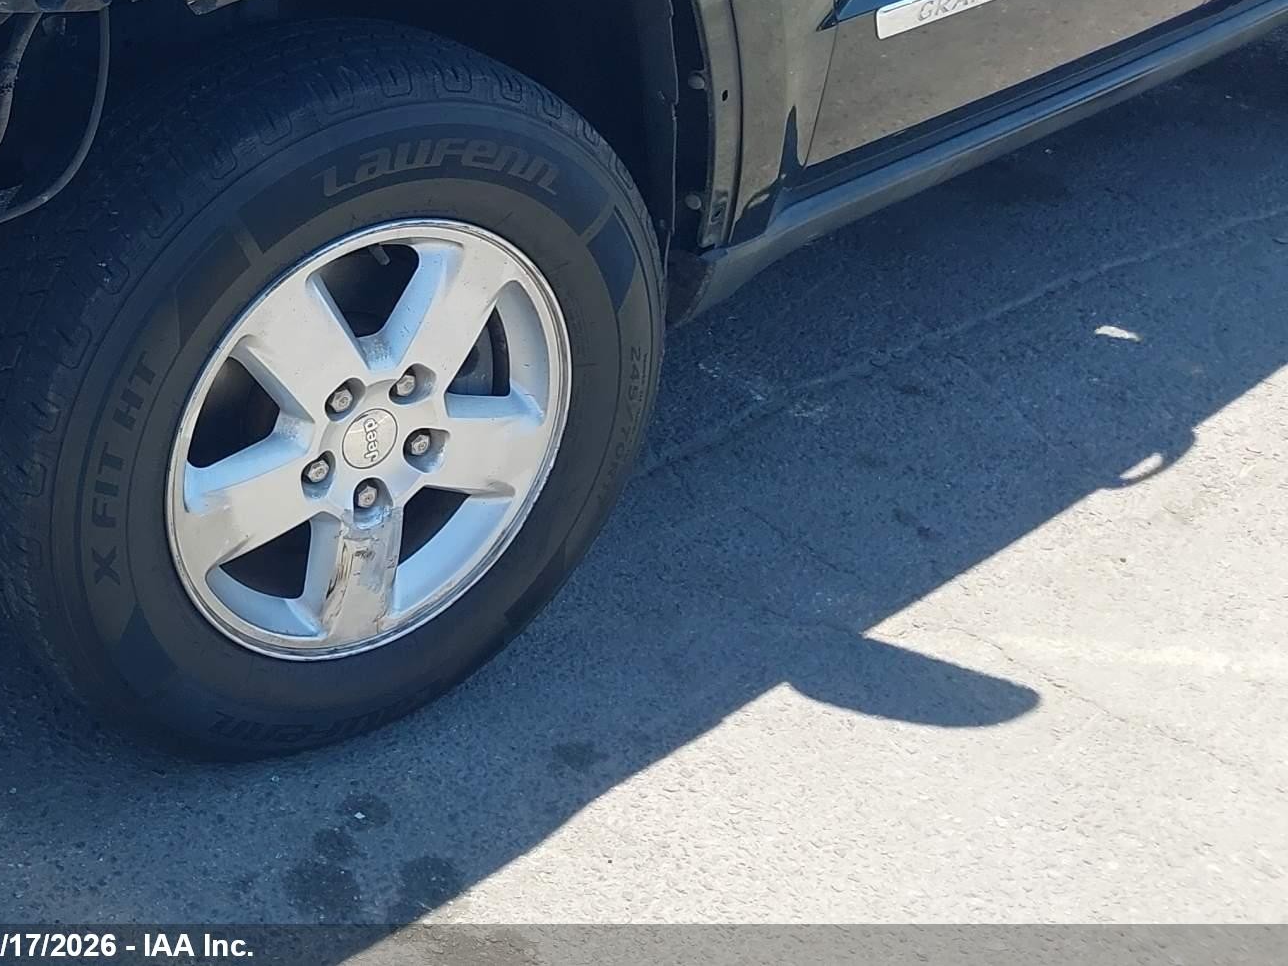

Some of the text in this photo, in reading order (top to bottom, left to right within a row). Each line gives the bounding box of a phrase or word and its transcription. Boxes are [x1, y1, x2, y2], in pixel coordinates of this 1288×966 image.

[312, 136, 557, 197] Laufenn
[91, 351, 157, 586] X FIT HT
[363, 417, 379, 463] Jeep
